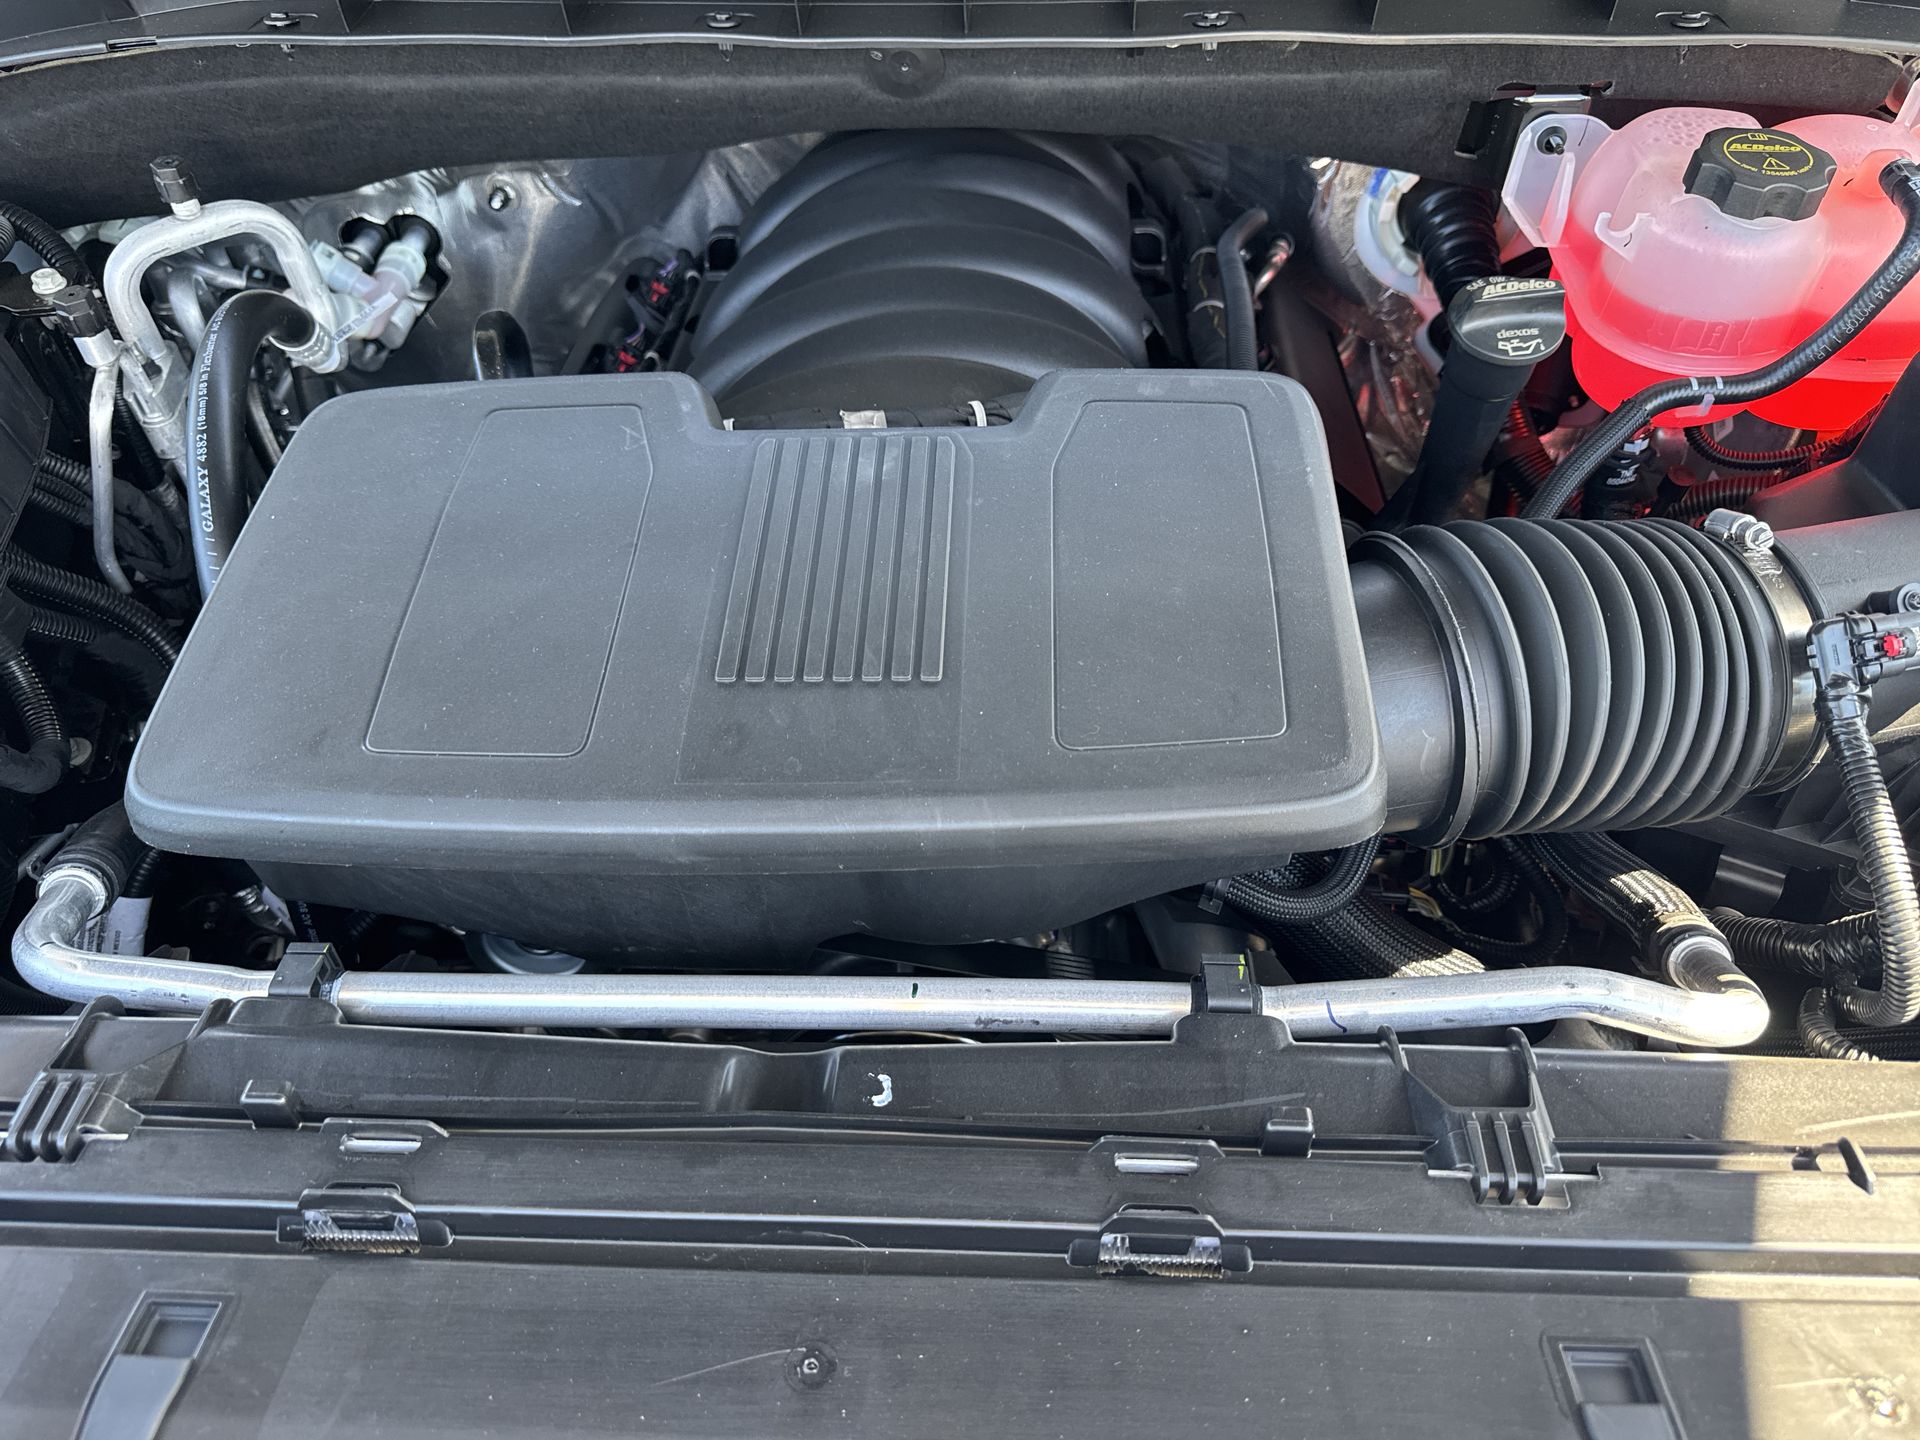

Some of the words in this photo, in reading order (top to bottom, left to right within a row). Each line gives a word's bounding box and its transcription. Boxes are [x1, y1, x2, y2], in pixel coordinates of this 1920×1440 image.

[1728, 142, 1802, 152] ACDelco
[1466, 279, 1487, 292] SAE
[1481, 279, 1557, 298] ACDelco
[1845, 303, 1876, 335] MOTOR
[1496, 327, 1541, 339] dexos
[198, 382, 208, 395] 5/8
[196, 433, 208, 462] 4882
[196, 466, 214, 533] GALAXY
